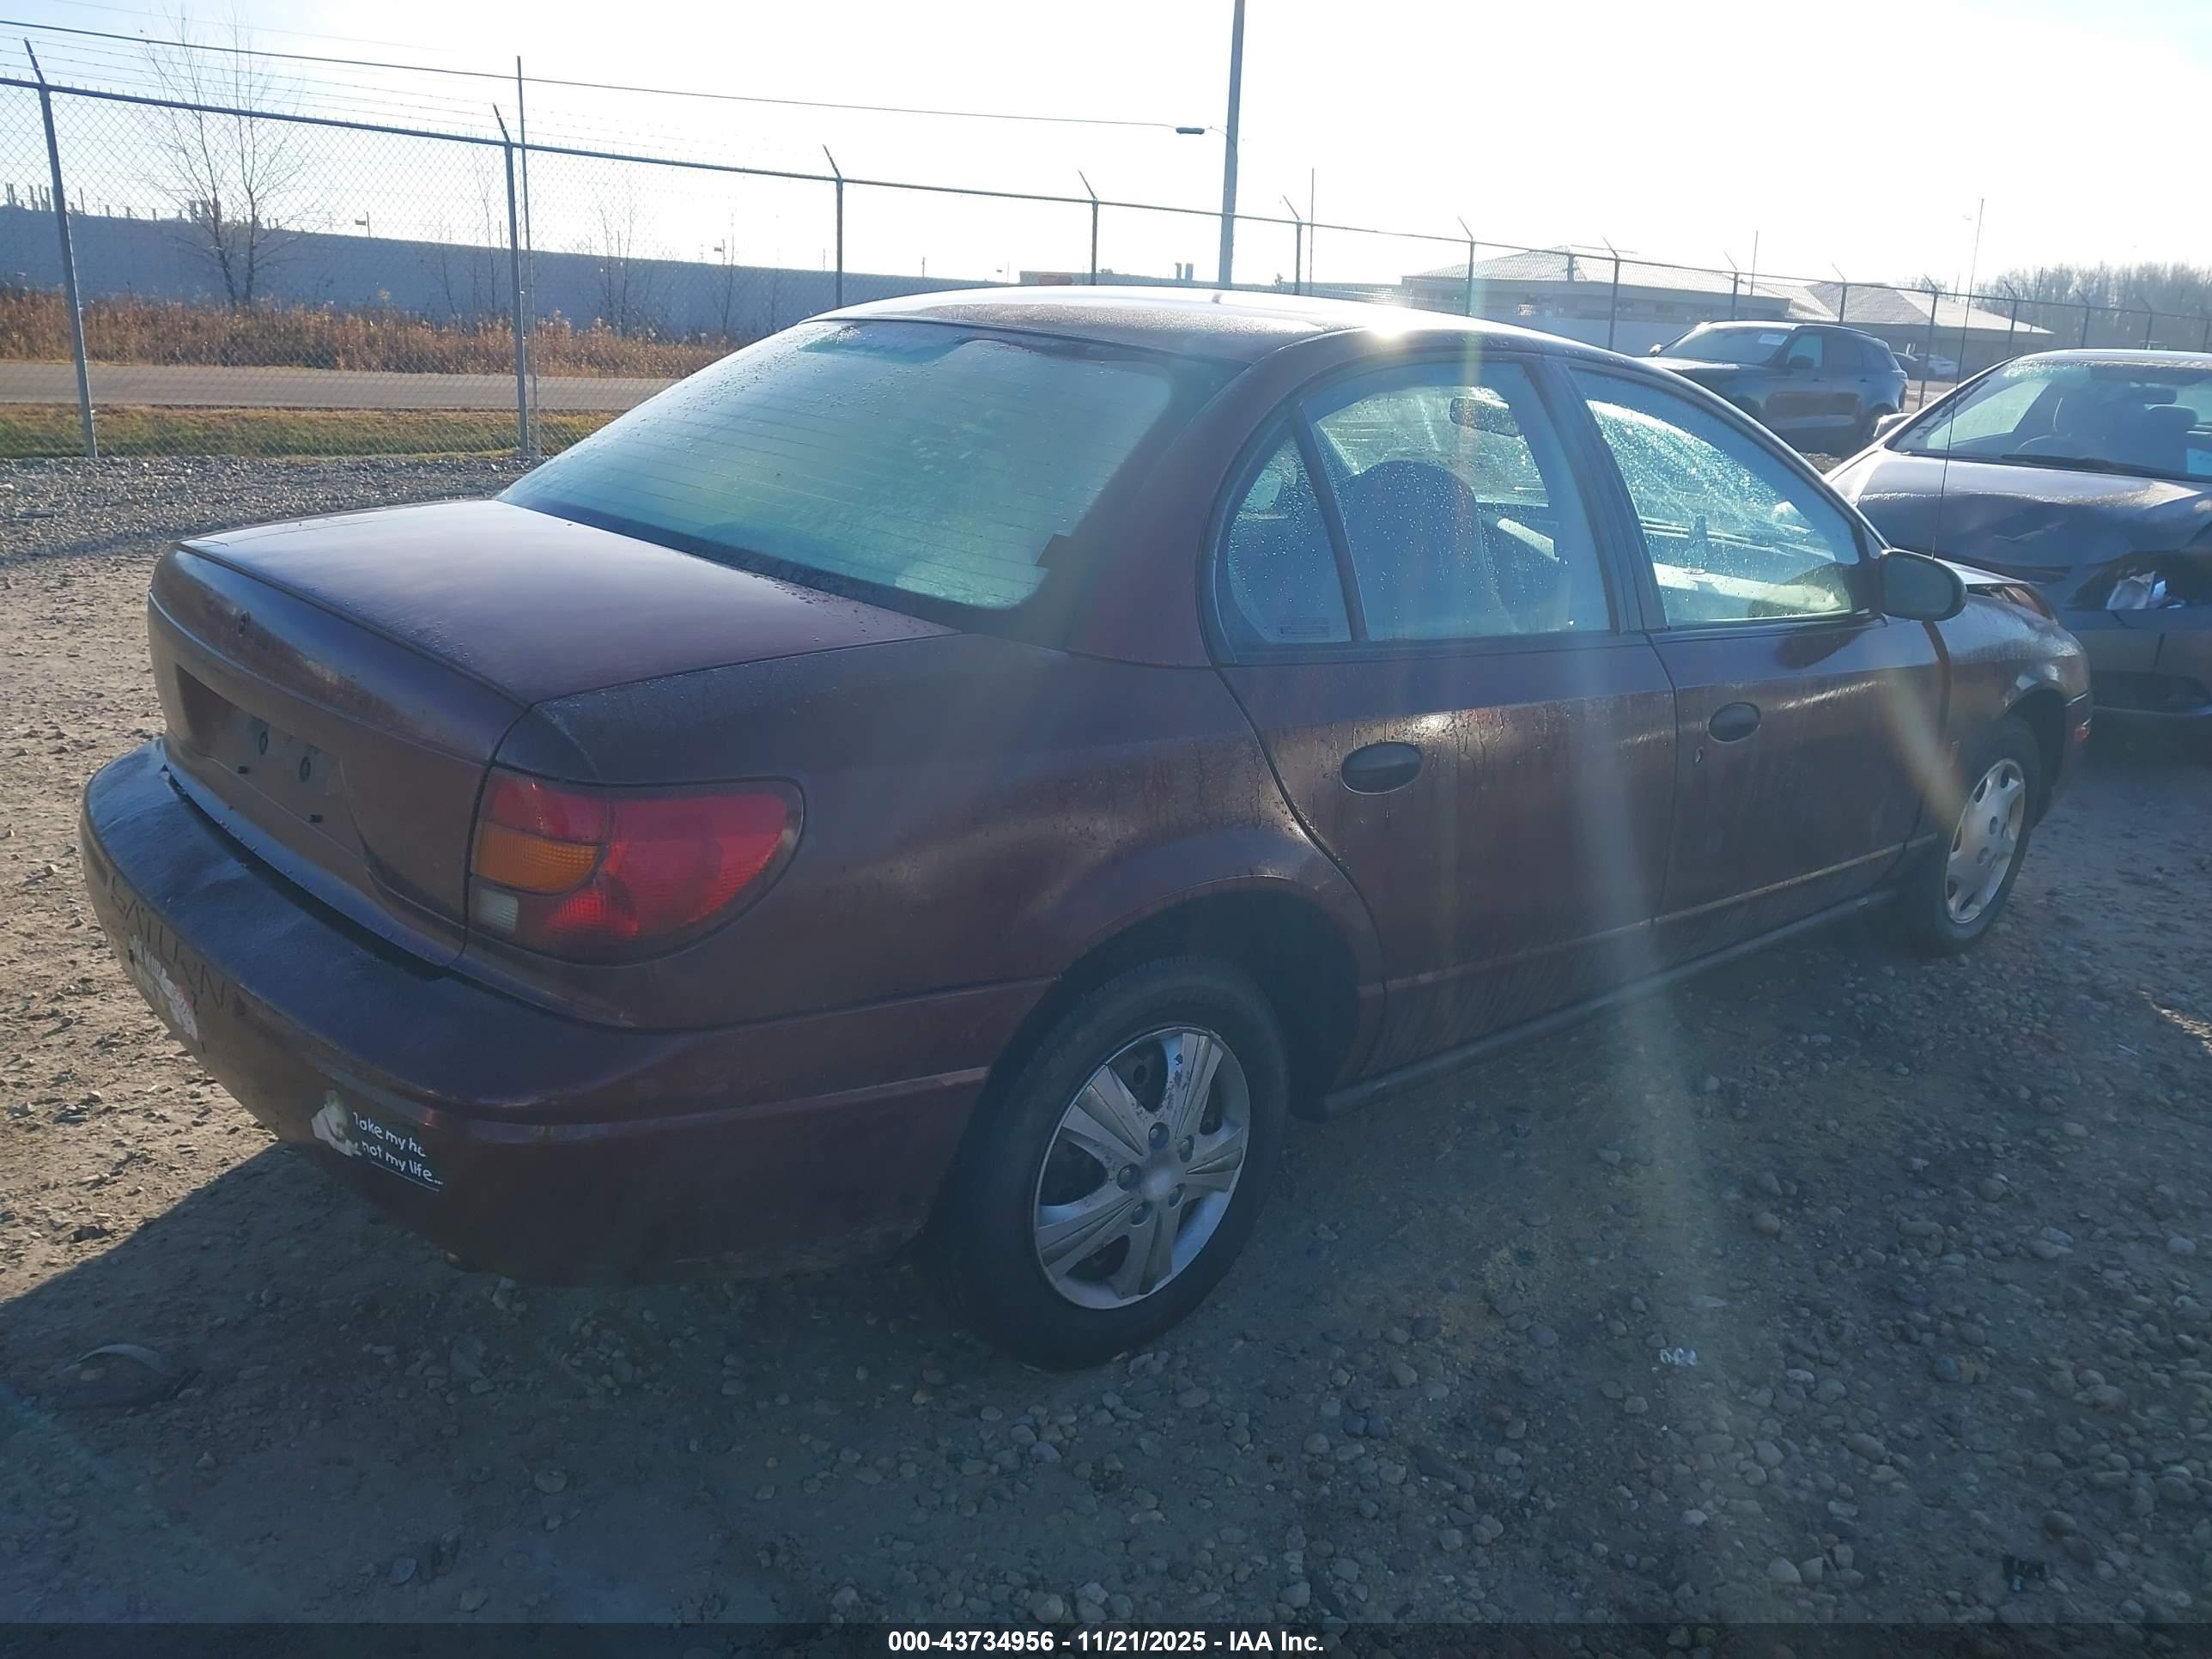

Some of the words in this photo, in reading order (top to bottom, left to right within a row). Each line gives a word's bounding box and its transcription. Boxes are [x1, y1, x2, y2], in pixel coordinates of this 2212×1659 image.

[386, 1129, 406, 1151] my
[362, 1140, 382, 1158] not
[386, 1152, 406, 1171] my
